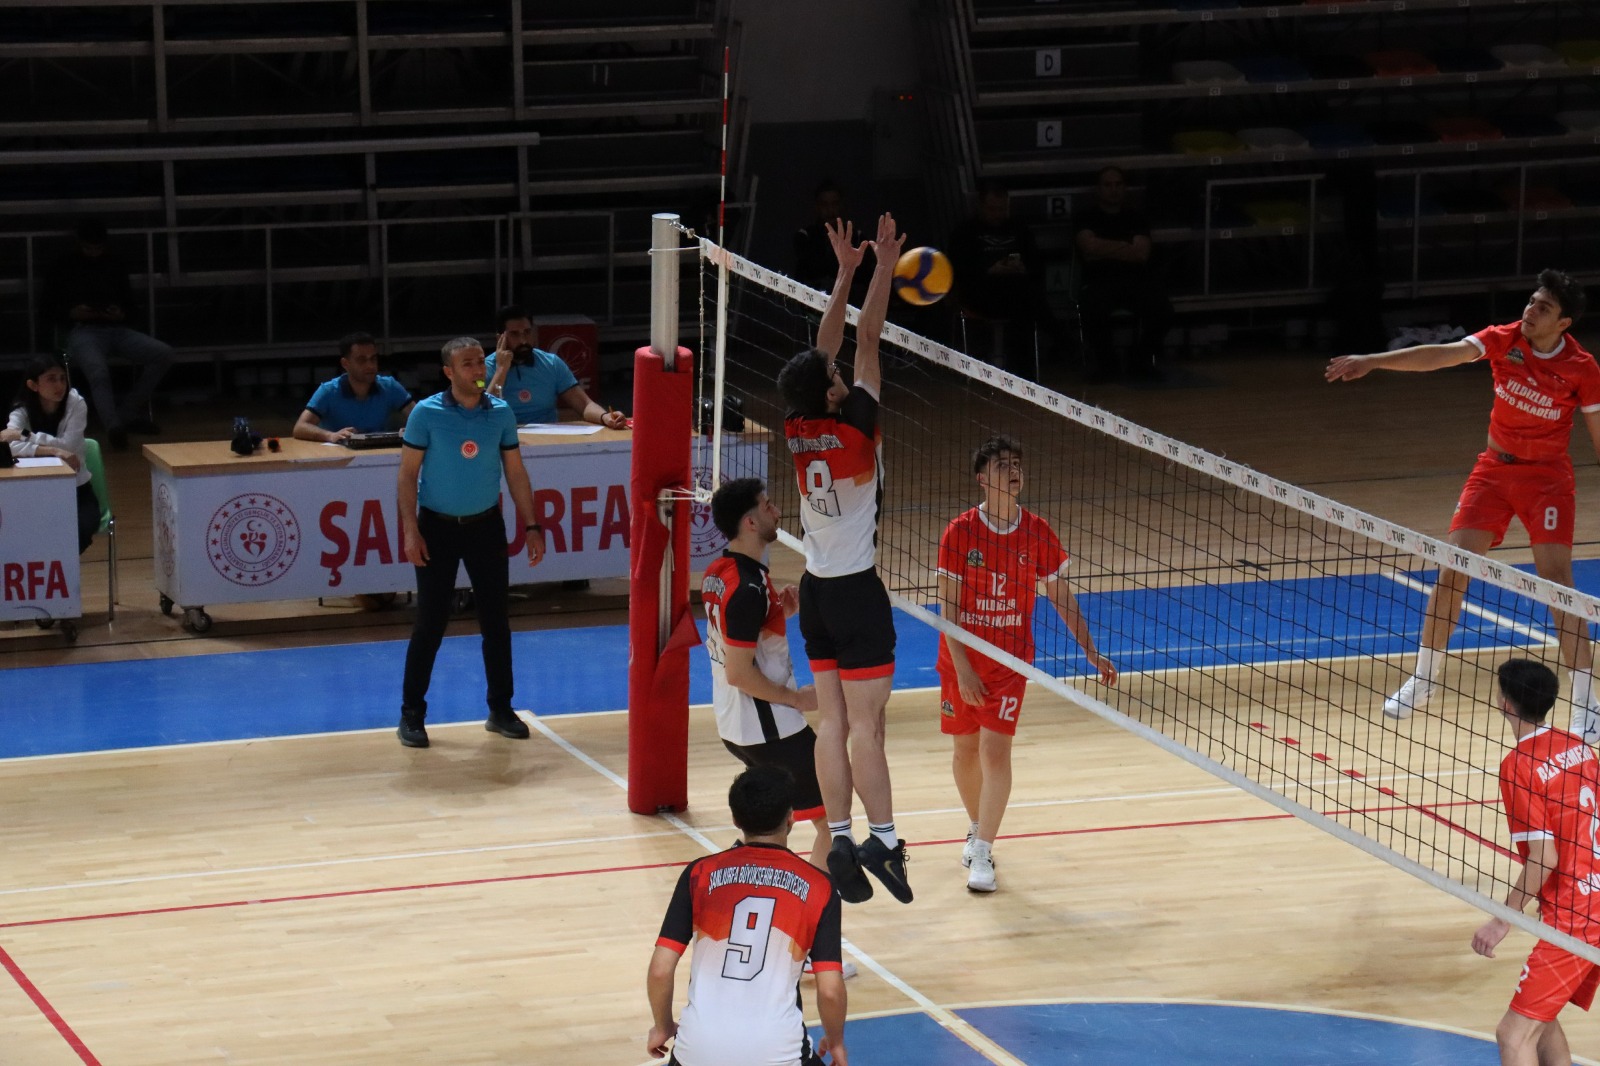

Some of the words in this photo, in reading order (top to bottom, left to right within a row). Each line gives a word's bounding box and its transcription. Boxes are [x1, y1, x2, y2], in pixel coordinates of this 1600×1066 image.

[1044, 54, 1052, 71] D
[1045, 126, 1054, 142] C
[1052, 198, 1066, 214] B
[1506, 378, 1554, 408] YILDIZLAR
[900, 333, 910, 344] TVF
[920, 342, 930, 353] TVF
[940, 350, 950, 362] TVF
[961, 359, 970, 371] TVF
[982, 368, 992, 379] TVF
[1004, 376, 1014, 390] TVF
[1026, 386, 1036, 398] TVF
[1048, 395, 1058, 407] TVF
[1070, 405, 1082, 418] TVF
[1094, 414, 1105, 426] TVF
[1118, 424, 1129, 436] TVF
[1142, 434, 1154, 446] TVF
[1168, 444, 1179, 457] TVF
[1192, 453, 1204, 466] TVF
[1220, 464, 1232, 478] TVF
[1247, 474, 1260, 488] TVF
[1274, 485, 1288, 498] TVF
[1302, 496, 1316, 510] TVF
[1332, 508, 1345, 522] TVF
[1360, 518, 1375, 532] TVF
[1392, 530, 1406, 544] TVF
[1422, 542, 1437, 556] TVF
[1454, 553, 1470, 568] TVF
[1488, 566, 1502, 580] TVF
[1522, 578, 1537, 593] TVF
[1556, 592, 1573, 607] TVF
[806, 459, 841, 518] 8
[1544, 506, 1558, 530] 8
[4, 560, 69, 601] RFA
[992, 572, 1007, 596] 12
[998, 696, 1018, 722] 12
[722, 895, 777, 981] 9
